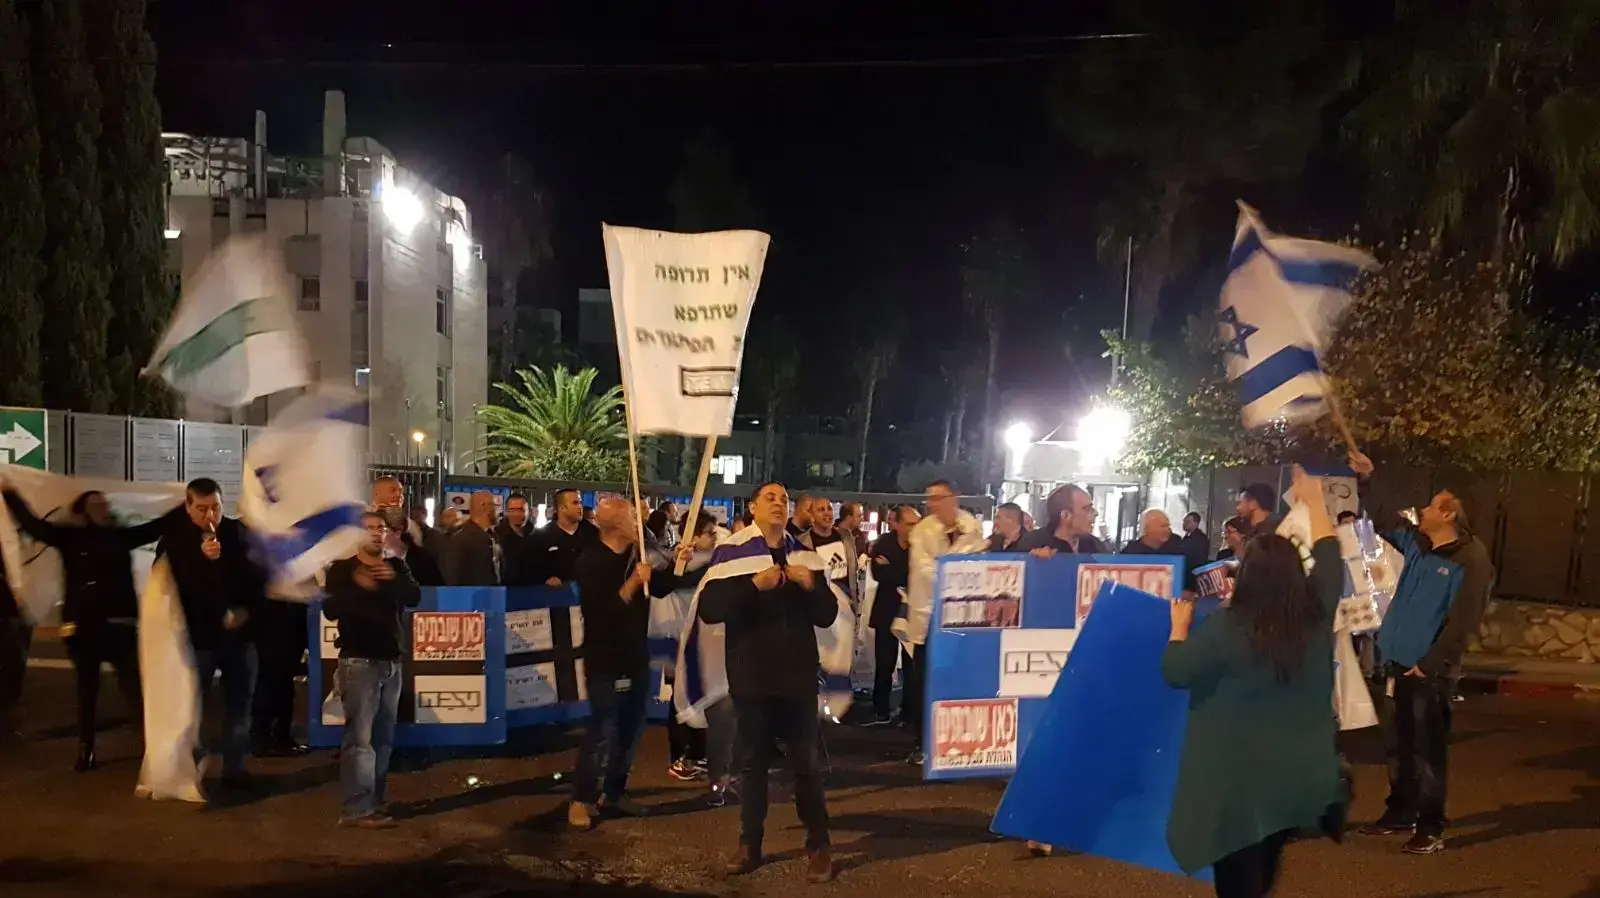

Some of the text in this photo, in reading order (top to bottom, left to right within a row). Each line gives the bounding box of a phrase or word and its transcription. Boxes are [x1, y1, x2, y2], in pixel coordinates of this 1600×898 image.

[654, 264, 750, 284] אין תרופה
[674, 303, 738, 321] שתרפא
[417, 616, 460, 643] שובתים
[462, 616, 482, 648] כאן
[936, 704, 1014, 747] כאן שובתים
